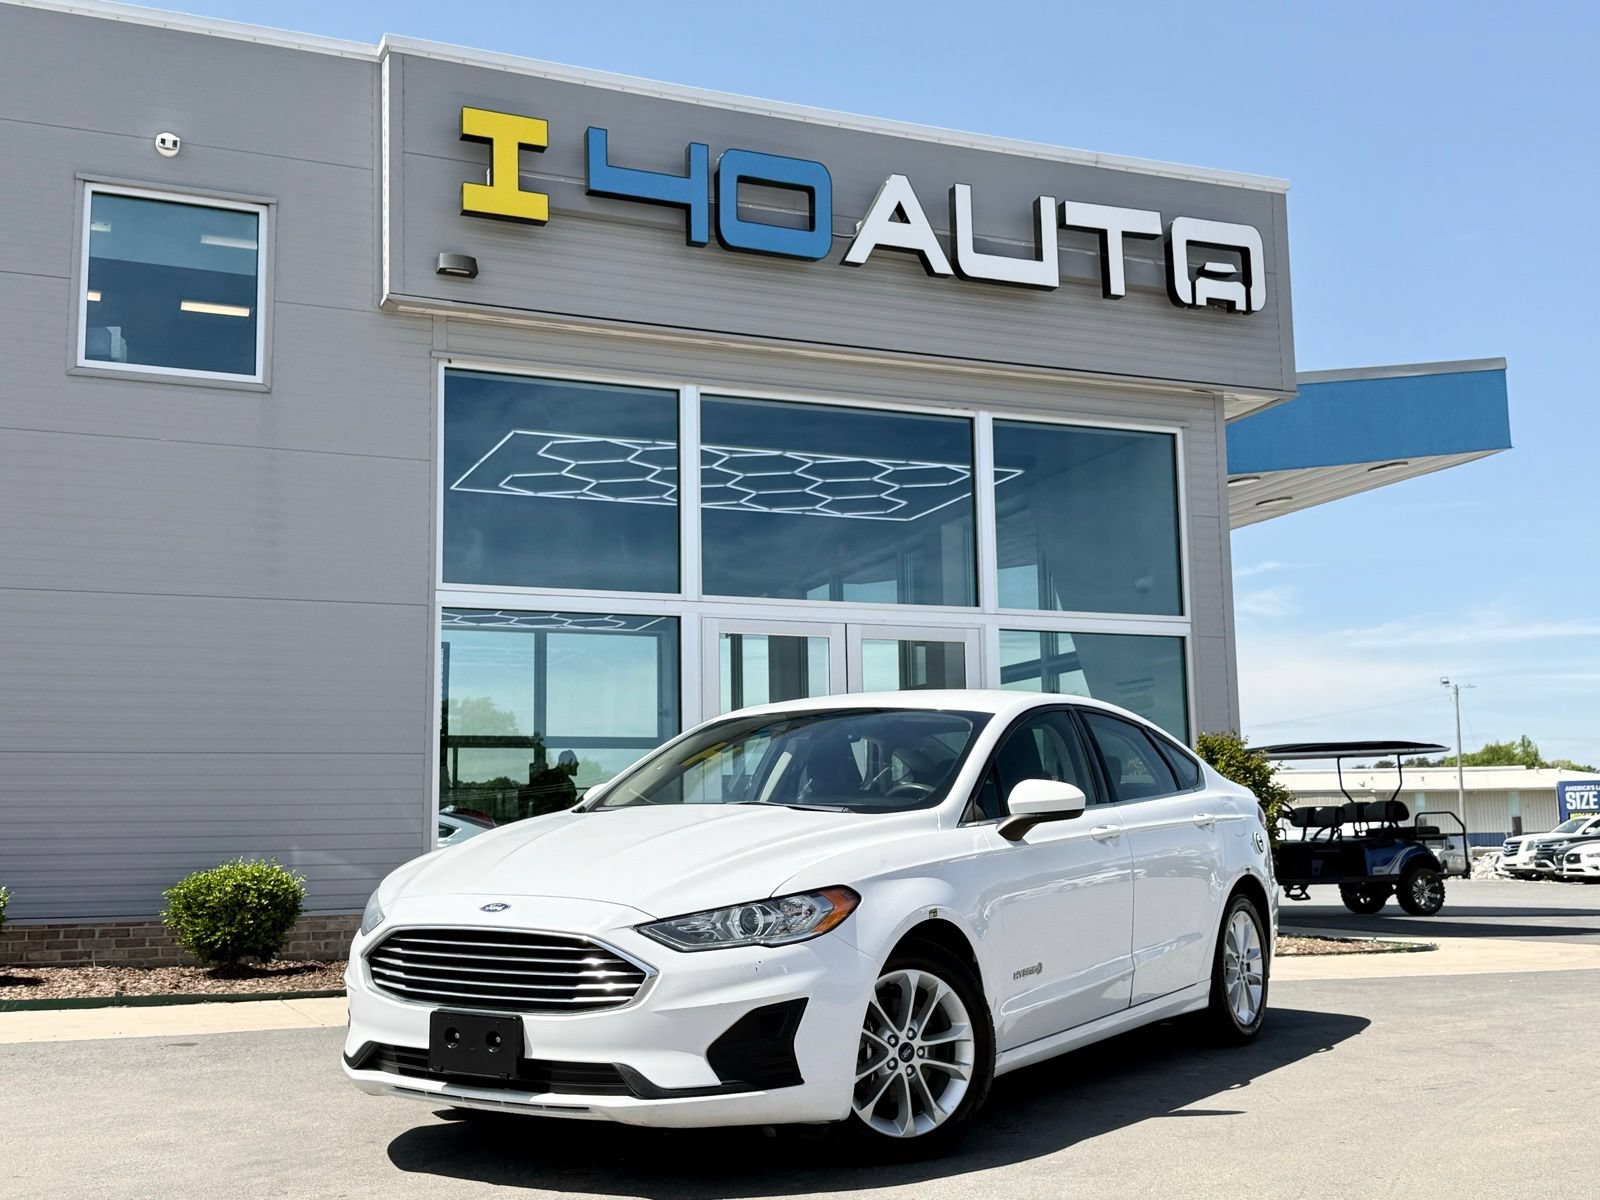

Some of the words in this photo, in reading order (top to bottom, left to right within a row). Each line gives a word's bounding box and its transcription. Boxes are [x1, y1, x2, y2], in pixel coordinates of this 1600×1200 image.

[461, 107, 549, 223] I
[585, 126, 833, 260] 40
[843, 173, 1266, 313] AUTO
[1566, 791, 1599, 810] SIZE
